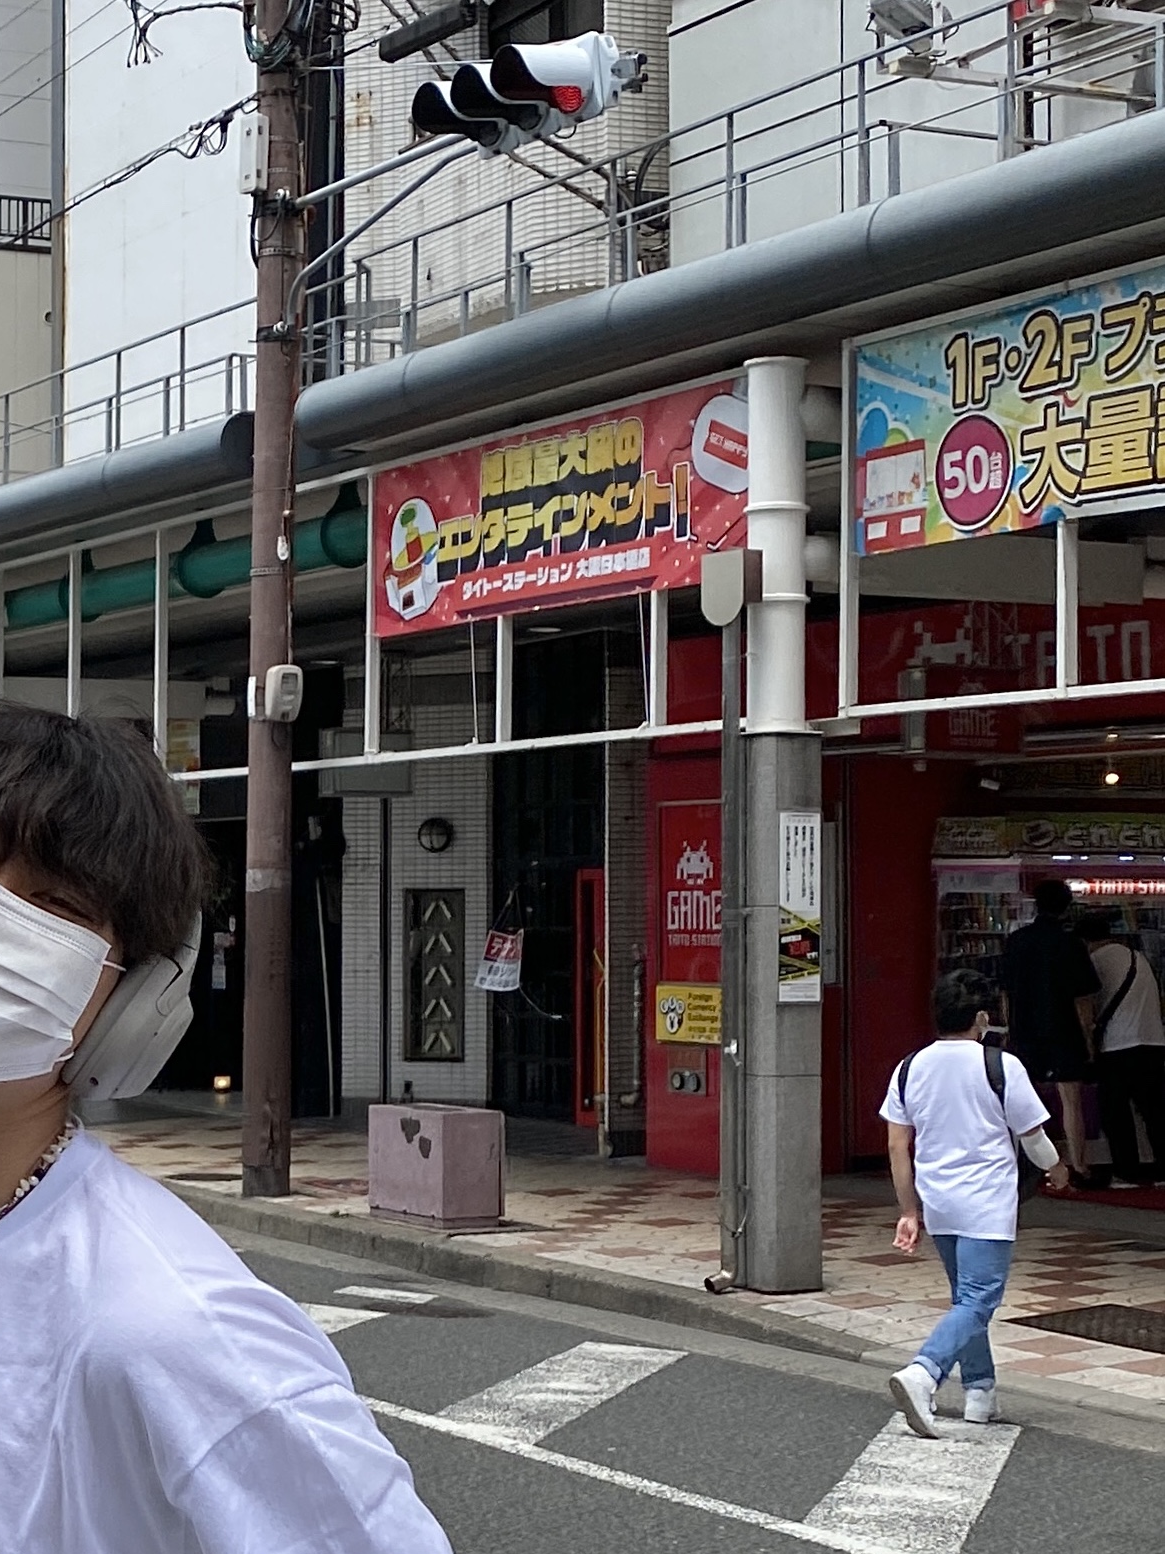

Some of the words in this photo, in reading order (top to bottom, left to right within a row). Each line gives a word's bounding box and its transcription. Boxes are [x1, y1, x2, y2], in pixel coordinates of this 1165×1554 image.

[463, 561, 574, 600] タイトーステーション
[1004, 620, 1151, 689] TATO
[667, 890, 723, 931] GAME
[687, 991, 713, 1002] Foreign
[687, 1002, 716, 1013] Currency
[687, 1012, 718, 1024] Exchange
